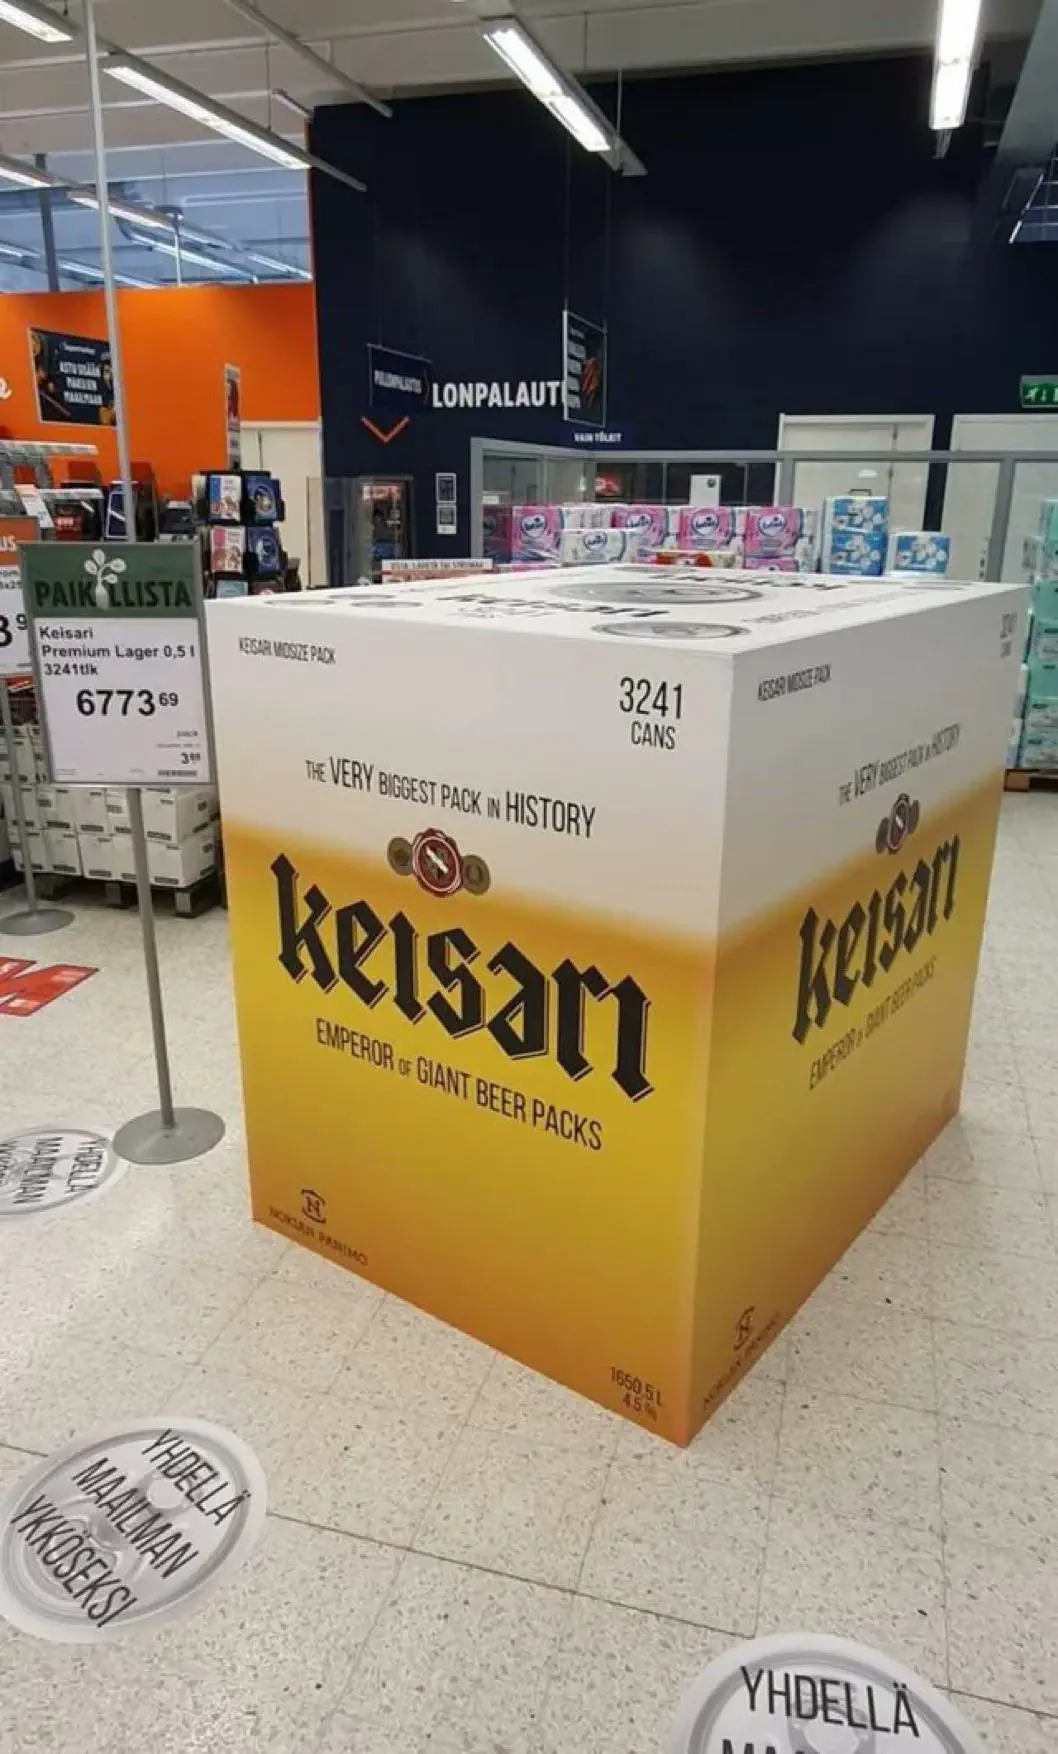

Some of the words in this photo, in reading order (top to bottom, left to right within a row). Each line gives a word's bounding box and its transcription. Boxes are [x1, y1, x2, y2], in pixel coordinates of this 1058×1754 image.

[0, 537, 16, 552] US
[35, 580, 192, 609] PAIKLLISTA
[16, 612, 28, 631] 9
[39, 625, 94, 641] Keisari
[42, 644, 111, 659] Premium
[115, 644, 159, 661] Lager
[163, 644, 187, 659] 0,5
[238, 636, 272, 656] KEISARI
[273, 640, 310, 662] MIDSIZE
[310, 645, 337, 665] PACK
[44, 662, 100, 677] 3241tlk
[618, 676, 683, 719] 3241
[631, 720, 676, 750] CANS
[854, 760, 880, 798] VERY
[305, 760, 328, 783] THE
[329, 757, 374, 793] VERY
[378, 771, 437, 806] BIGGEST
[440, 784, 482, 816] PACK
[487, 797, 500, 819] IN
[505, 791, 597, 839] HISTORY
[316, 1017, 395, 1071] EMPEROR
[398, 1057, 413, 1076] OF
[416, 1056, 471, 1101] GIANT
[476, 1077, 527, 1122] BEER
[532, 1098, 603, 1152] PACKS
[142, 1428, 252, 1527] YHDELLÄ
[72, 1457, 199, 1580] MAAILMAN
[10, 1494, 138, 1628] YKKÖSEKSI
[740, 1665, 920, 1738] YHDELLÄ
